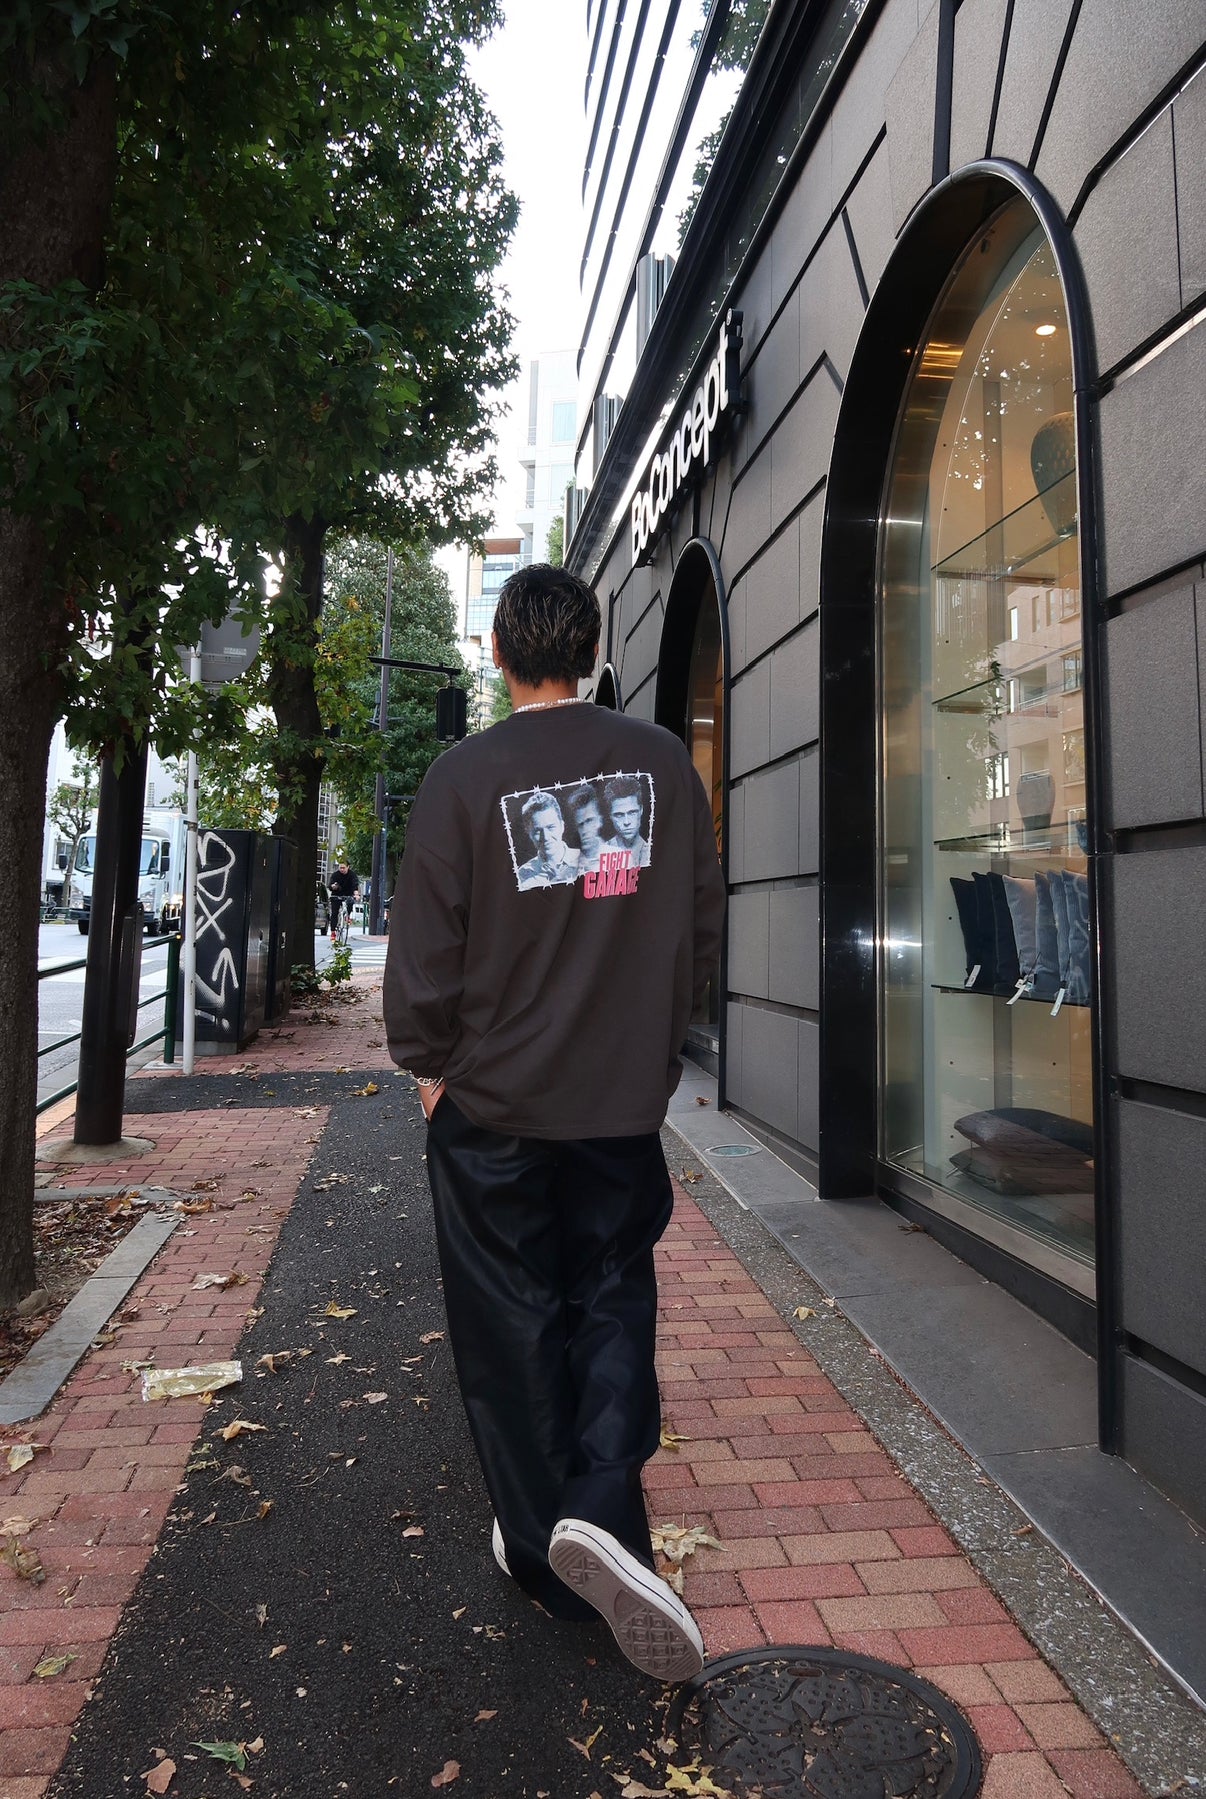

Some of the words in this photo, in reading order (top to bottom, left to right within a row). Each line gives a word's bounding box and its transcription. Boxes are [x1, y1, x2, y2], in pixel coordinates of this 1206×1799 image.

[632, 323, 728, 567] BoConcept
[599, 850, 632, 870] FIGHT
[583, 866, 641, 898] GARAGE
